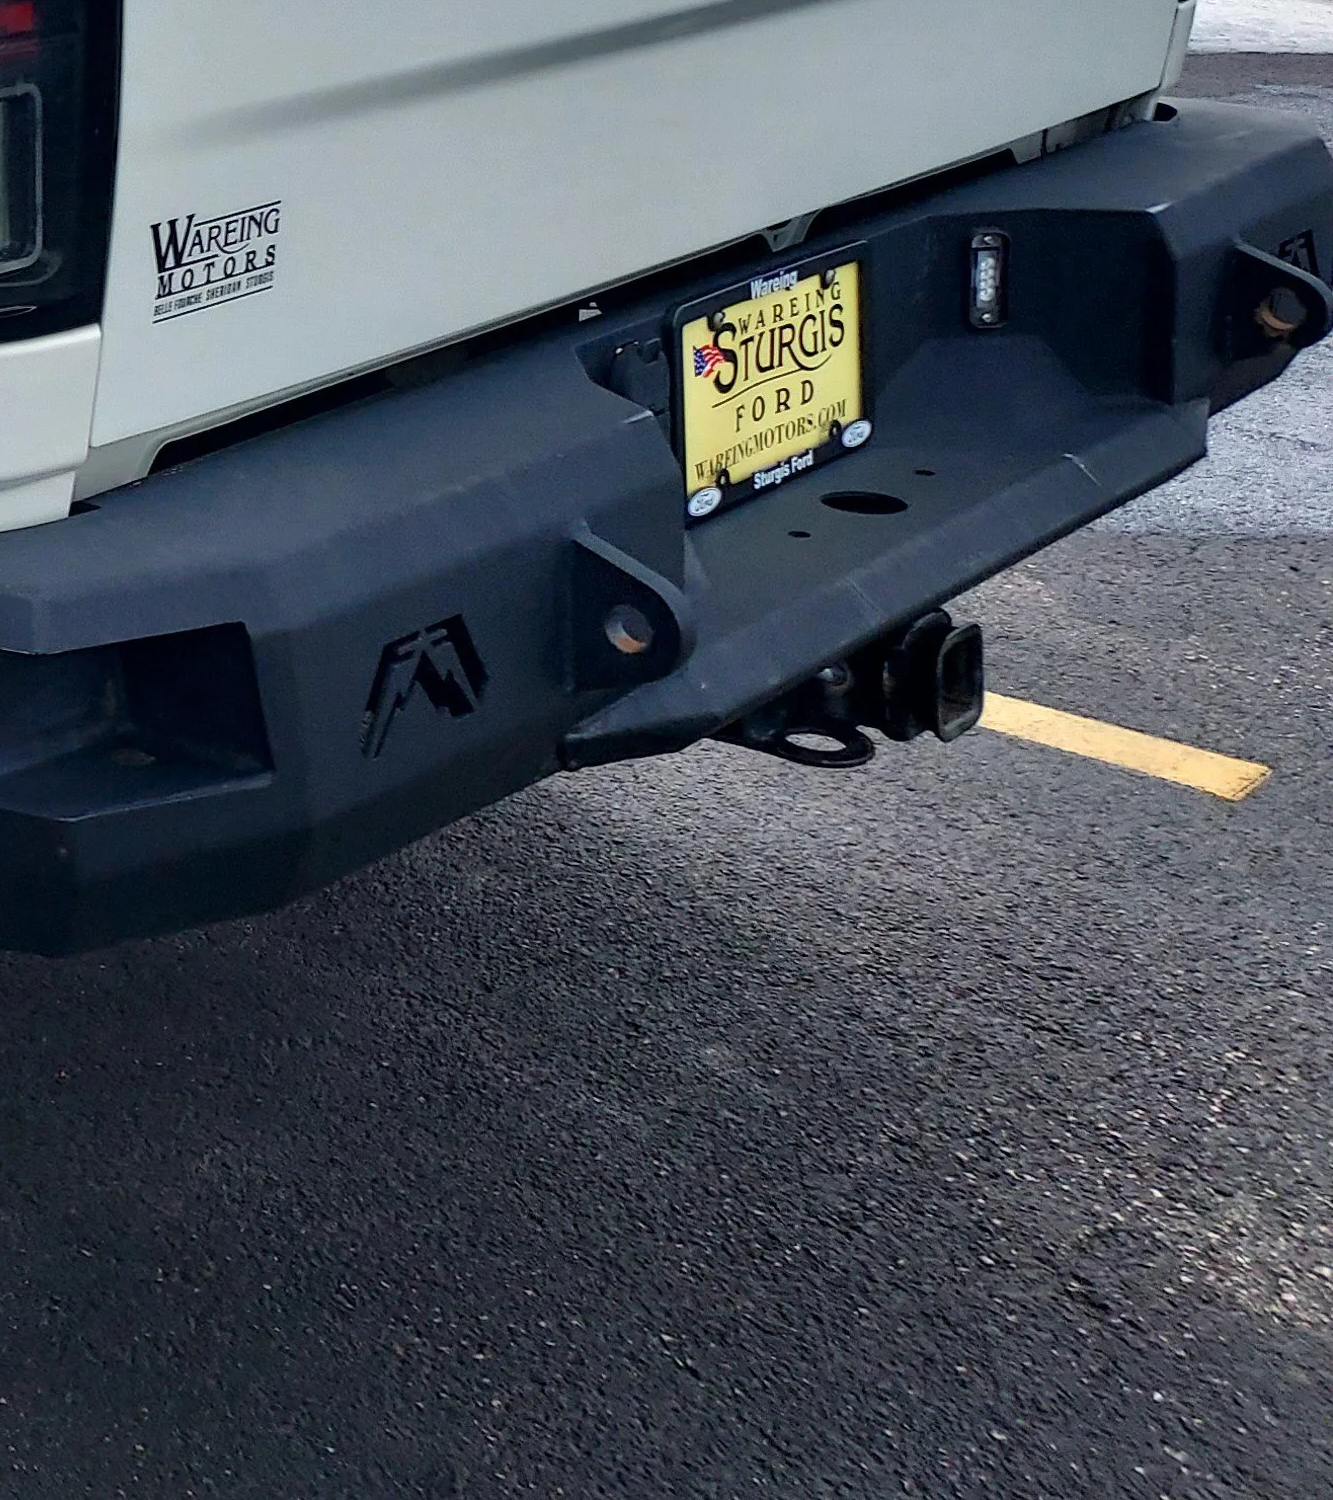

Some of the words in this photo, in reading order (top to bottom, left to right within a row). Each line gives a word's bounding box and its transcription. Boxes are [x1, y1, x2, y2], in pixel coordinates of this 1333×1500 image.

[150, 207, 280, 273] WAREING
[155, 245, 276, 299] MOTORS
[751, 270, 798, 299] Wareing
[738, 282, 841, 335] WAREING
[713, 303, 844, 394] STURGIS
[735, 379, 814, 433] FORD
[695, 399, 846, 481] WAREINGMOTORS.COM
[753, 460, 790, 489] Sturgis
[791, 449, 815, 473] Ford
